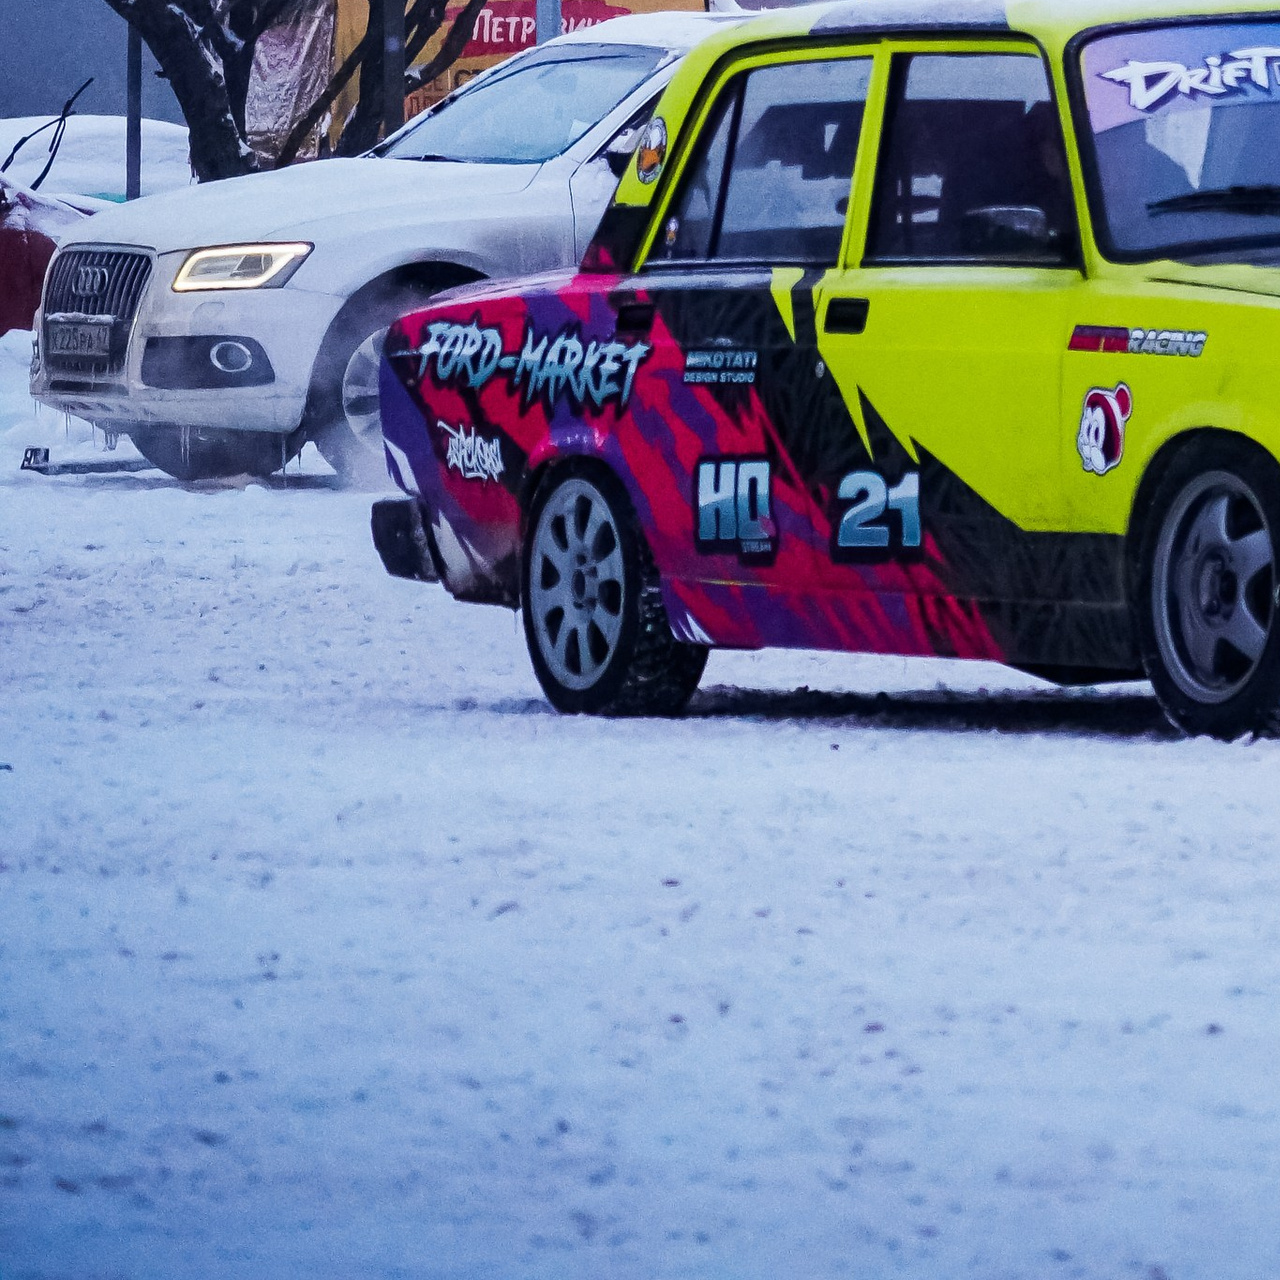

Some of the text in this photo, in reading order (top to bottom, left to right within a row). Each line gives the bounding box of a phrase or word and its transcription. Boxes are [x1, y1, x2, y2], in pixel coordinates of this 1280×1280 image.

[419, 320, 652, 407] FORD-MARKET
[1129, 328, 1208, 357] RACING
[837, 470, 921, 547] 21
